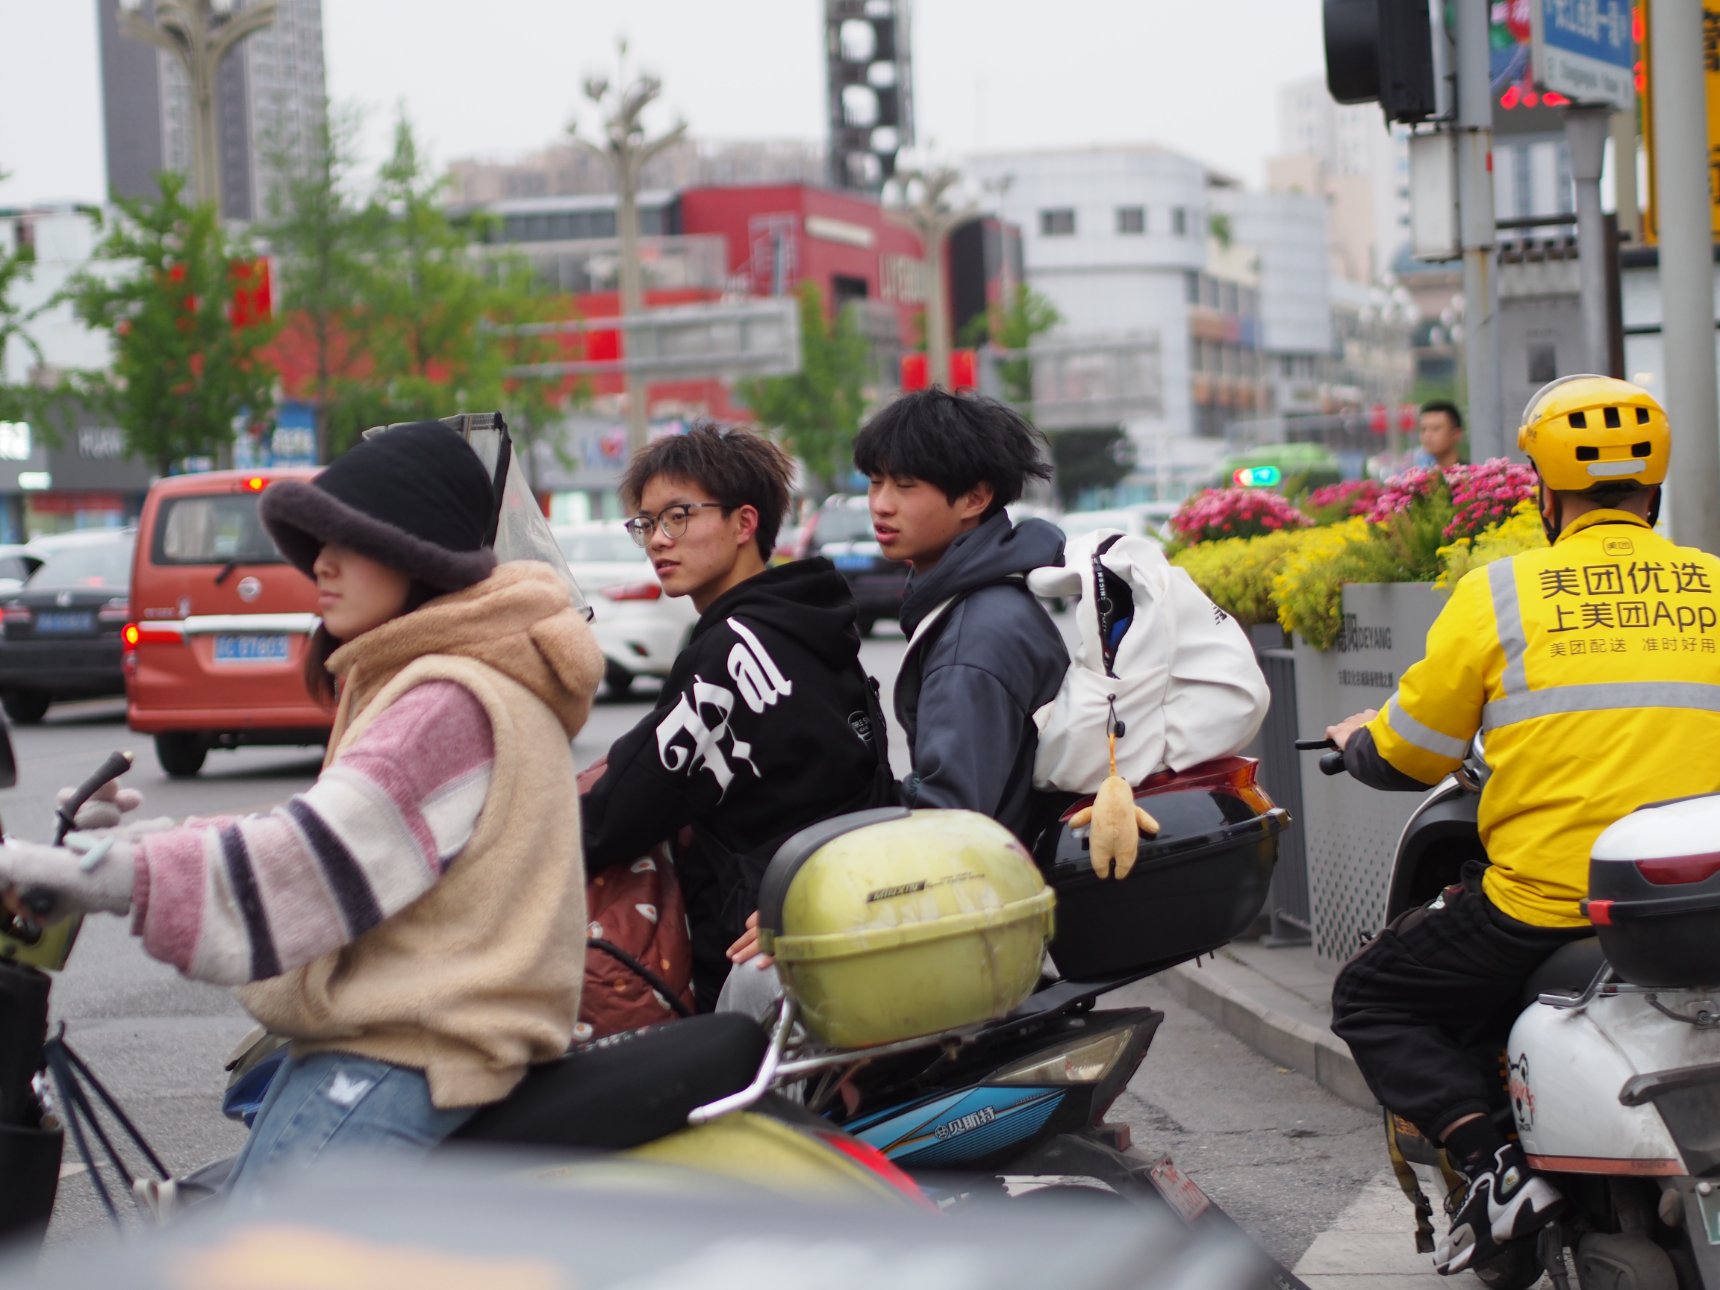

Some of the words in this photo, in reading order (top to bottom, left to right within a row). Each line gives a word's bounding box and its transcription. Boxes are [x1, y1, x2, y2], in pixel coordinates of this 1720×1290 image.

[1538, 561, 1712, 599] 美团优选
[1547, 600, 1717, 634] 上美团App
[1549, 638, 1627, 658] 美团配送
[1642, 637, 1716, 654] 准时好用
[948, 1106, 996, 1136] 贝斯特
